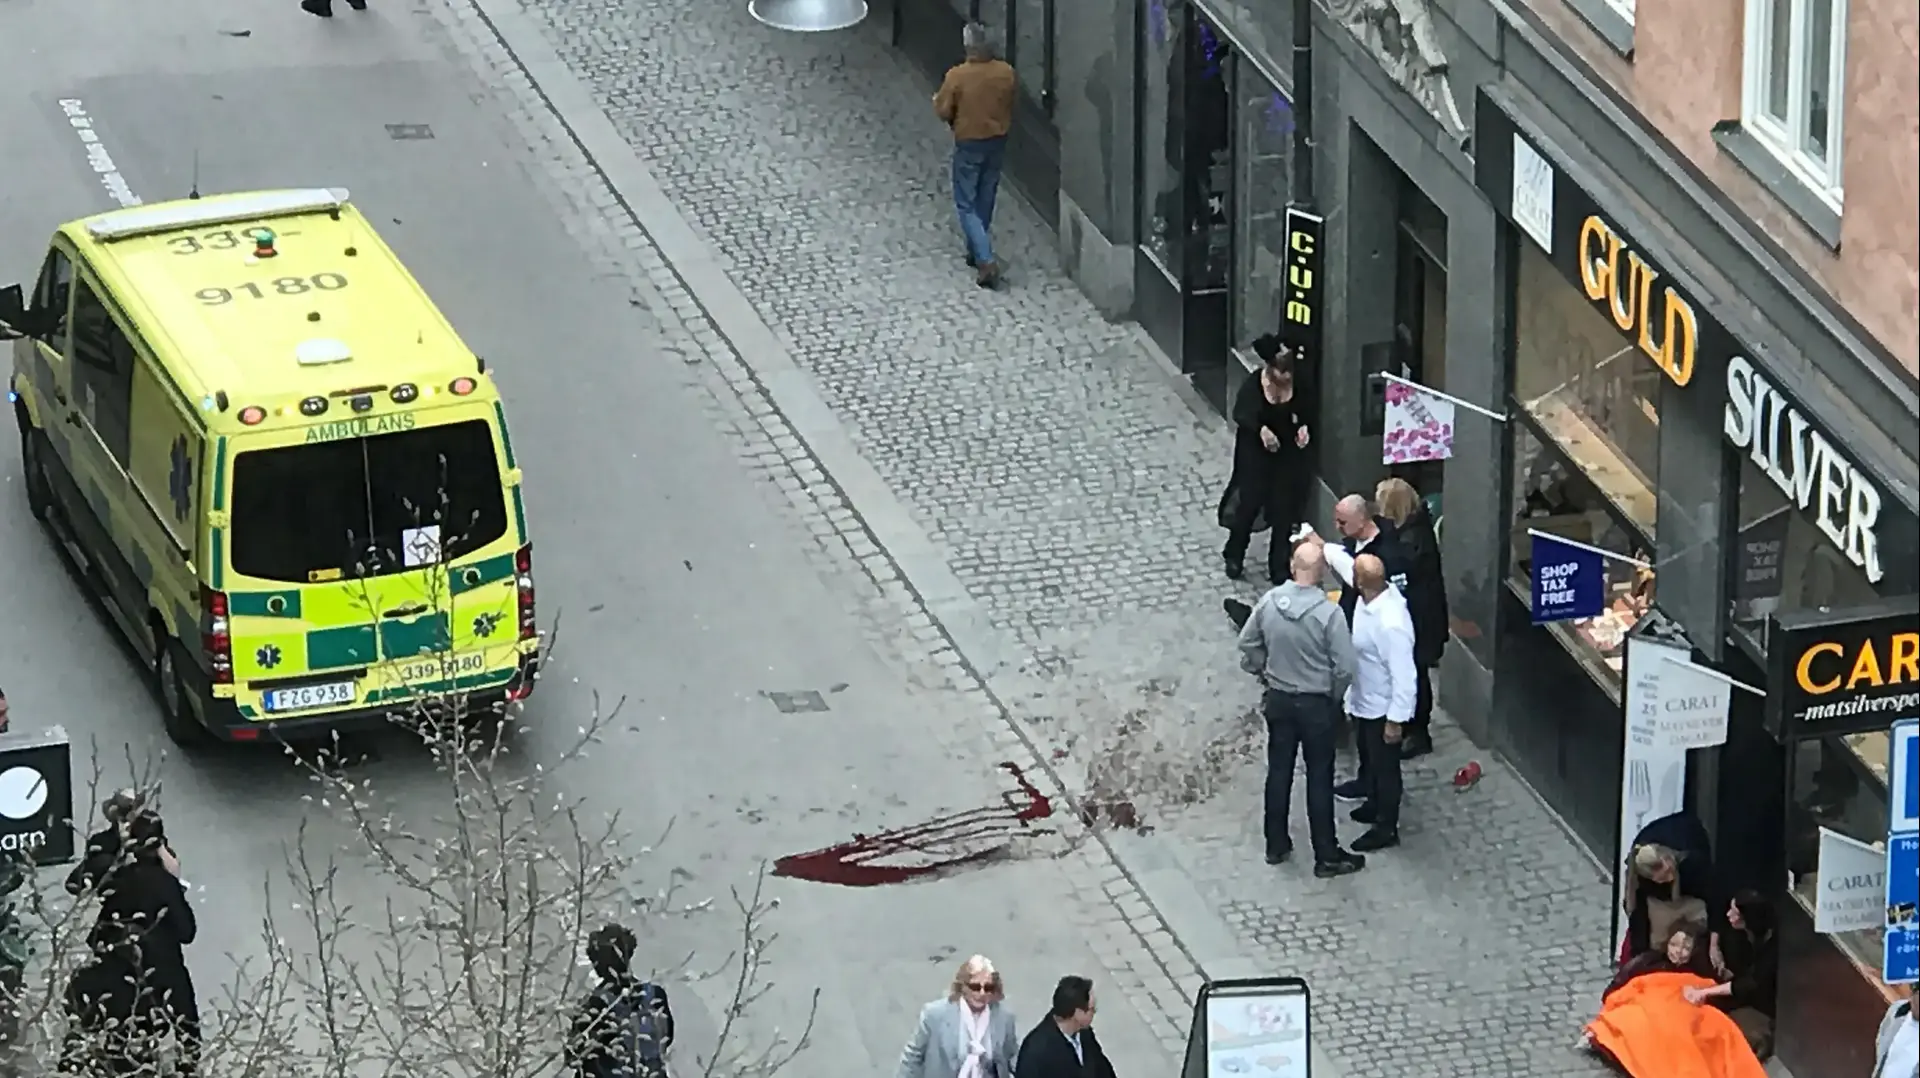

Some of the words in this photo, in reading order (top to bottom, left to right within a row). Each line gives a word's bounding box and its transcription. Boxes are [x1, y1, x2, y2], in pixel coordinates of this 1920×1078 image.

[195, 272, 348, 306] 9180
[1580, 215, 1699, 387] GULD
[306, 412, 415, 441] AMBULANS
[1724, 356, 1884, 583] SILVER
[1541, 562, 1578, 579] SHOP
[1541, 577, 1567, 592] TAX
[1541, 589, 1575, 606] FREE
[1796, 633, 1919, 695] CAR
[279, 689, 311, 706] FZG
[316, 684, 348, 702] 938
[1665, 694, 1719, 712] CARAT
[0, 830, 46, 851] arn
[1828, 871, 1884, 892] CARAT
